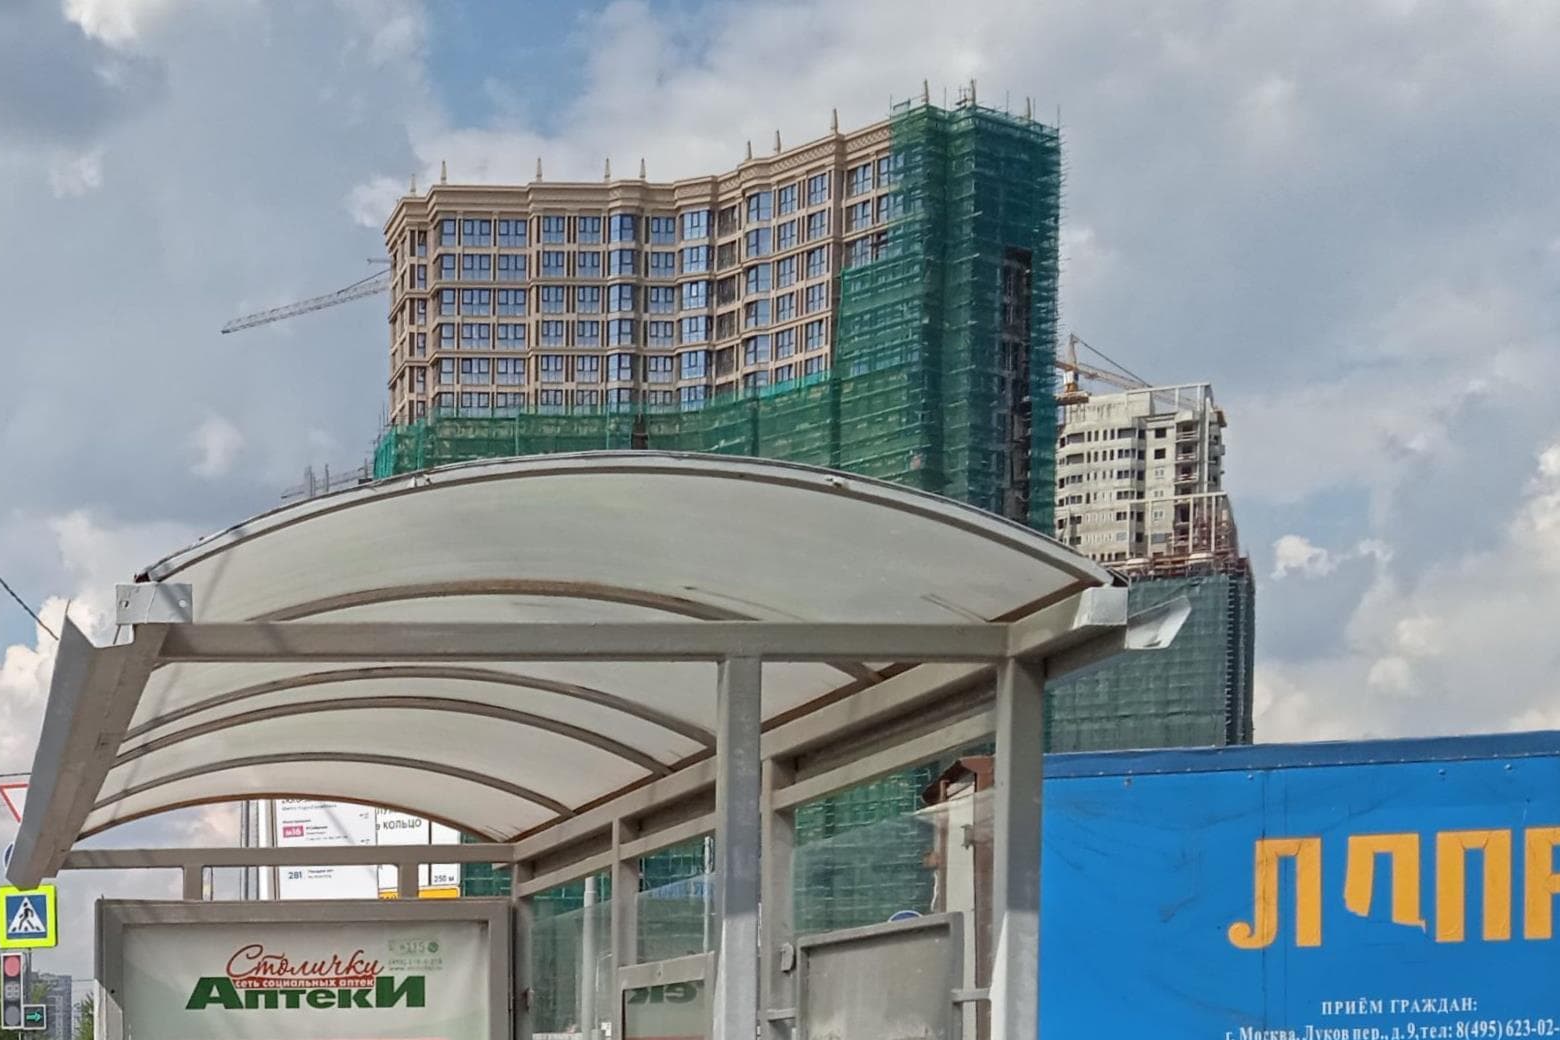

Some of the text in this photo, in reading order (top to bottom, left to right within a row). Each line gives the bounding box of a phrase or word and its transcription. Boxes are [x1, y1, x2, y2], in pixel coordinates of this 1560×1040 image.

[226, 944, 384, 977] Столички
[235, 978, 375, 988] сеть социальных аптек
[1321, 998, 1477, 1015] ПРИЁМ ГРАЖДАН:
